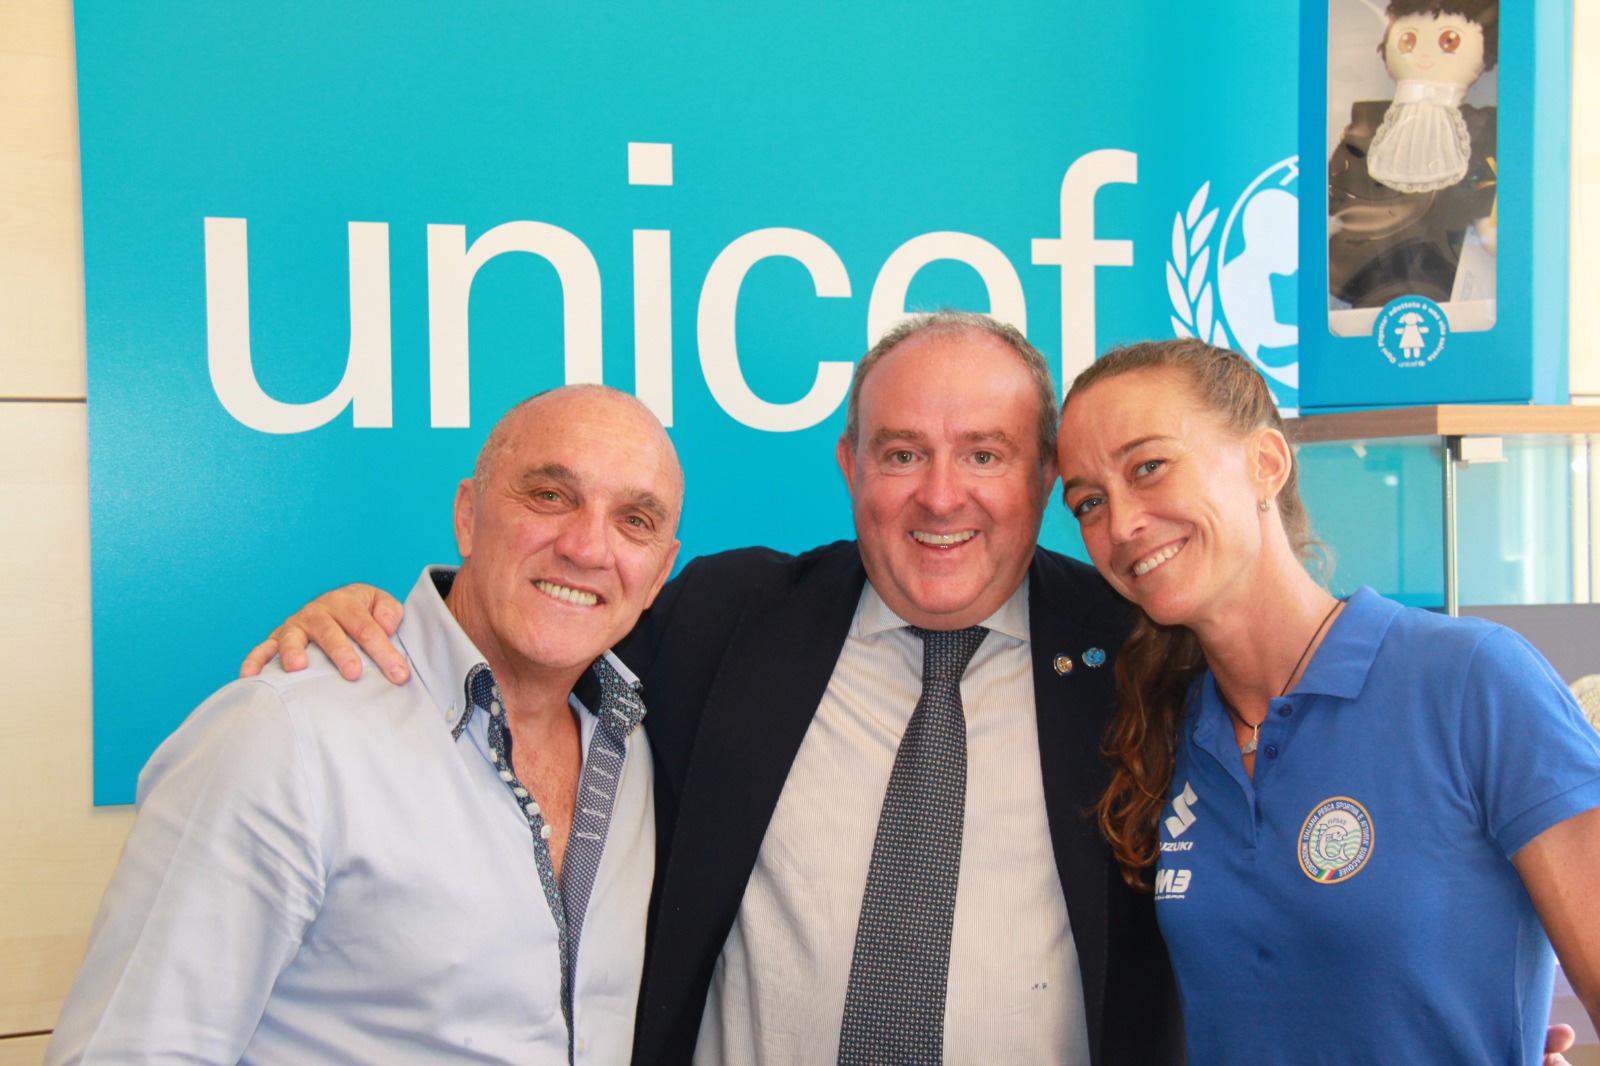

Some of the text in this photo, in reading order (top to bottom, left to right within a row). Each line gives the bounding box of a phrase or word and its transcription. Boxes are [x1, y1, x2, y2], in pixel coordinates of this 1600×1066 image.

[203, 142, 1138, 434] unicef
[1388, 302, 1421, 316] adottata
[1317, 803, 1335, 817] PESCA
[1335, 801, 1360, 816] SPORTIVA
[1303, 815, 1319, 840] ITALIANA
[1160, 841, 1193, 852] UZUKI
[1301, 842, 1319, 876] FEDERAZIONE
[1339, 847, 1368, 877] SUBACQUEE
